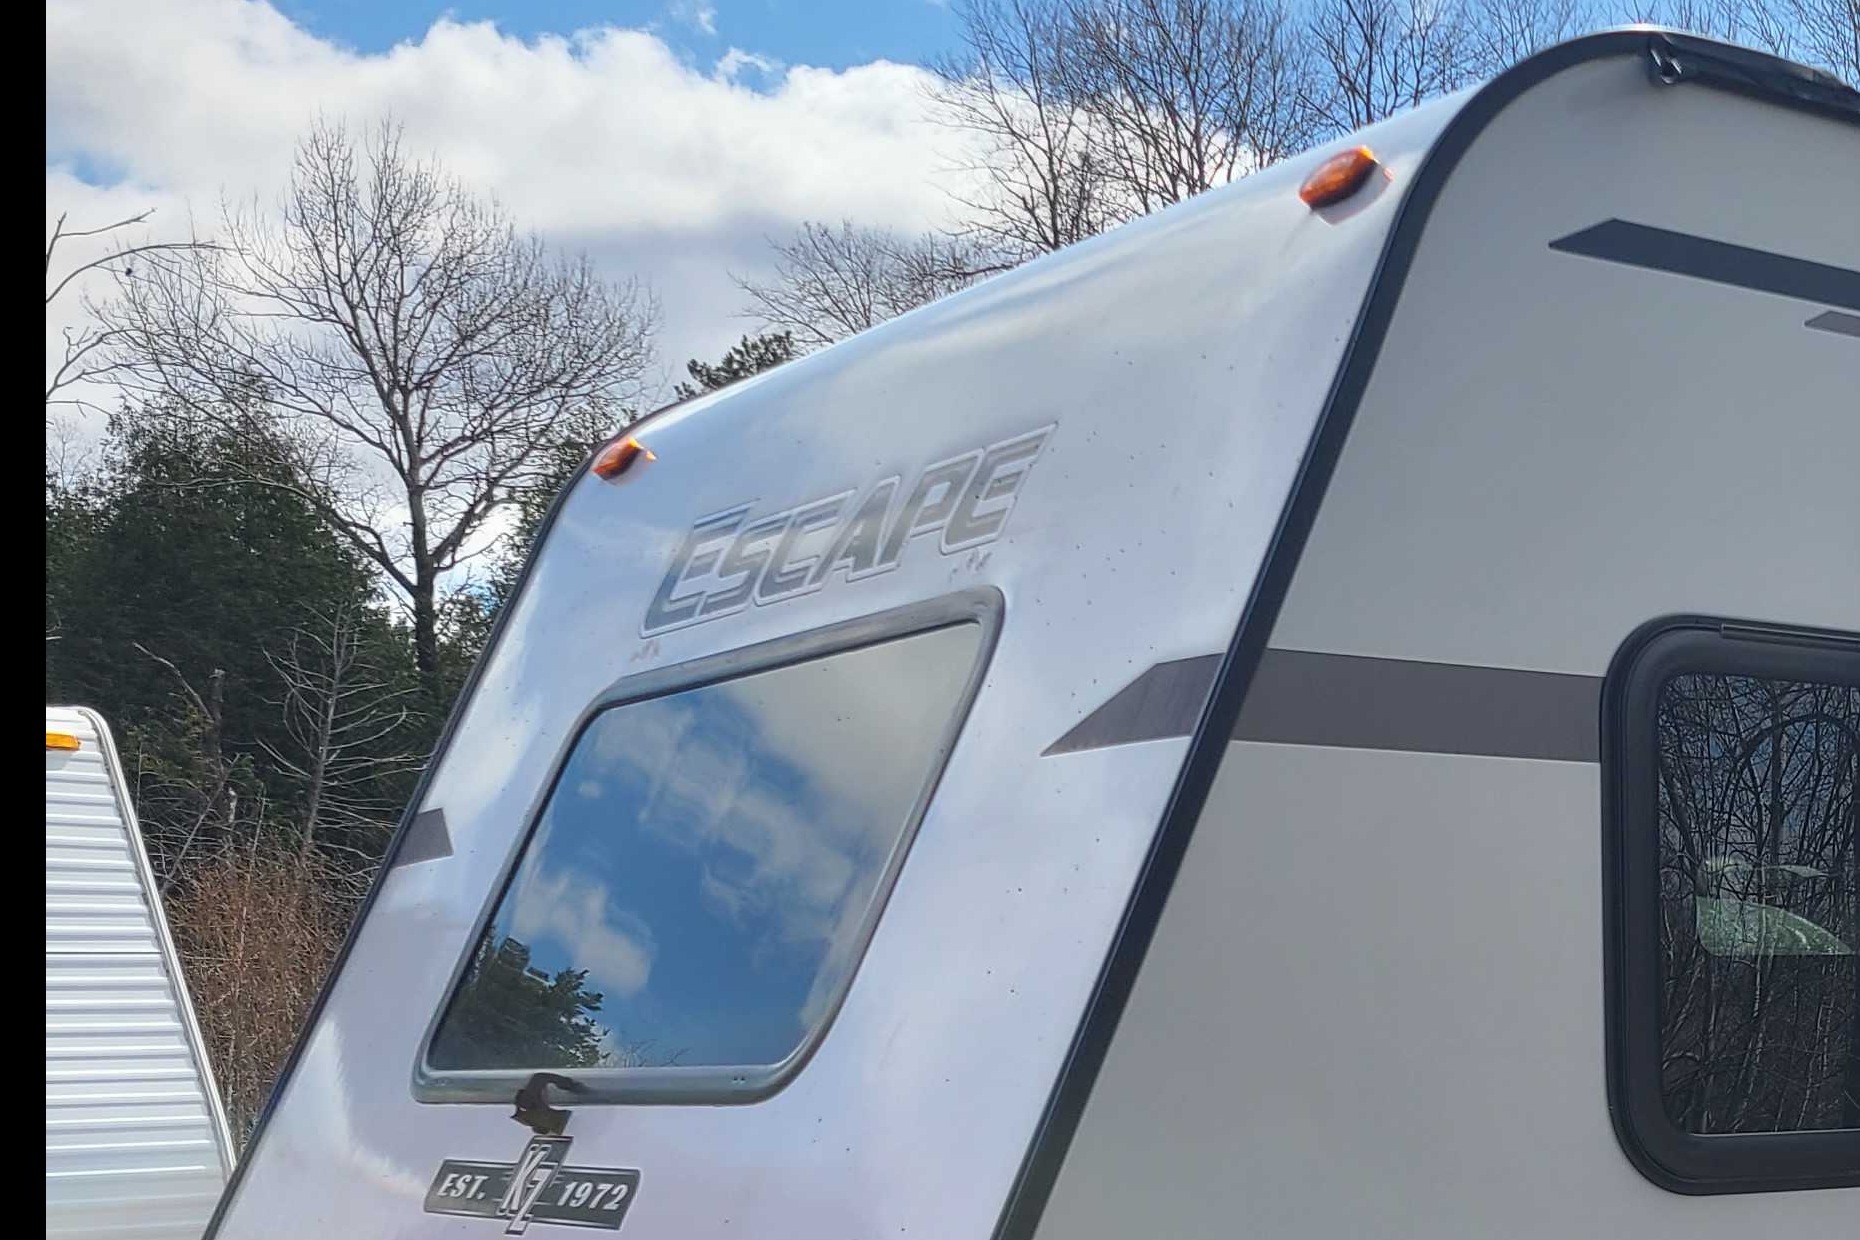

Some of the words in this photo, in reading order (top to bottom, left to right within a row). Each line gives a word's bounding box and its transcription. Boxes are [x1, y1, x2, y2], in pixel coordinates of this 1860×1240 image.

[639, 421, 1058, 638] ESCAPE
[436, 1173, 489, 1200] EST.
[557, 1181, 629, 1211] 1972
